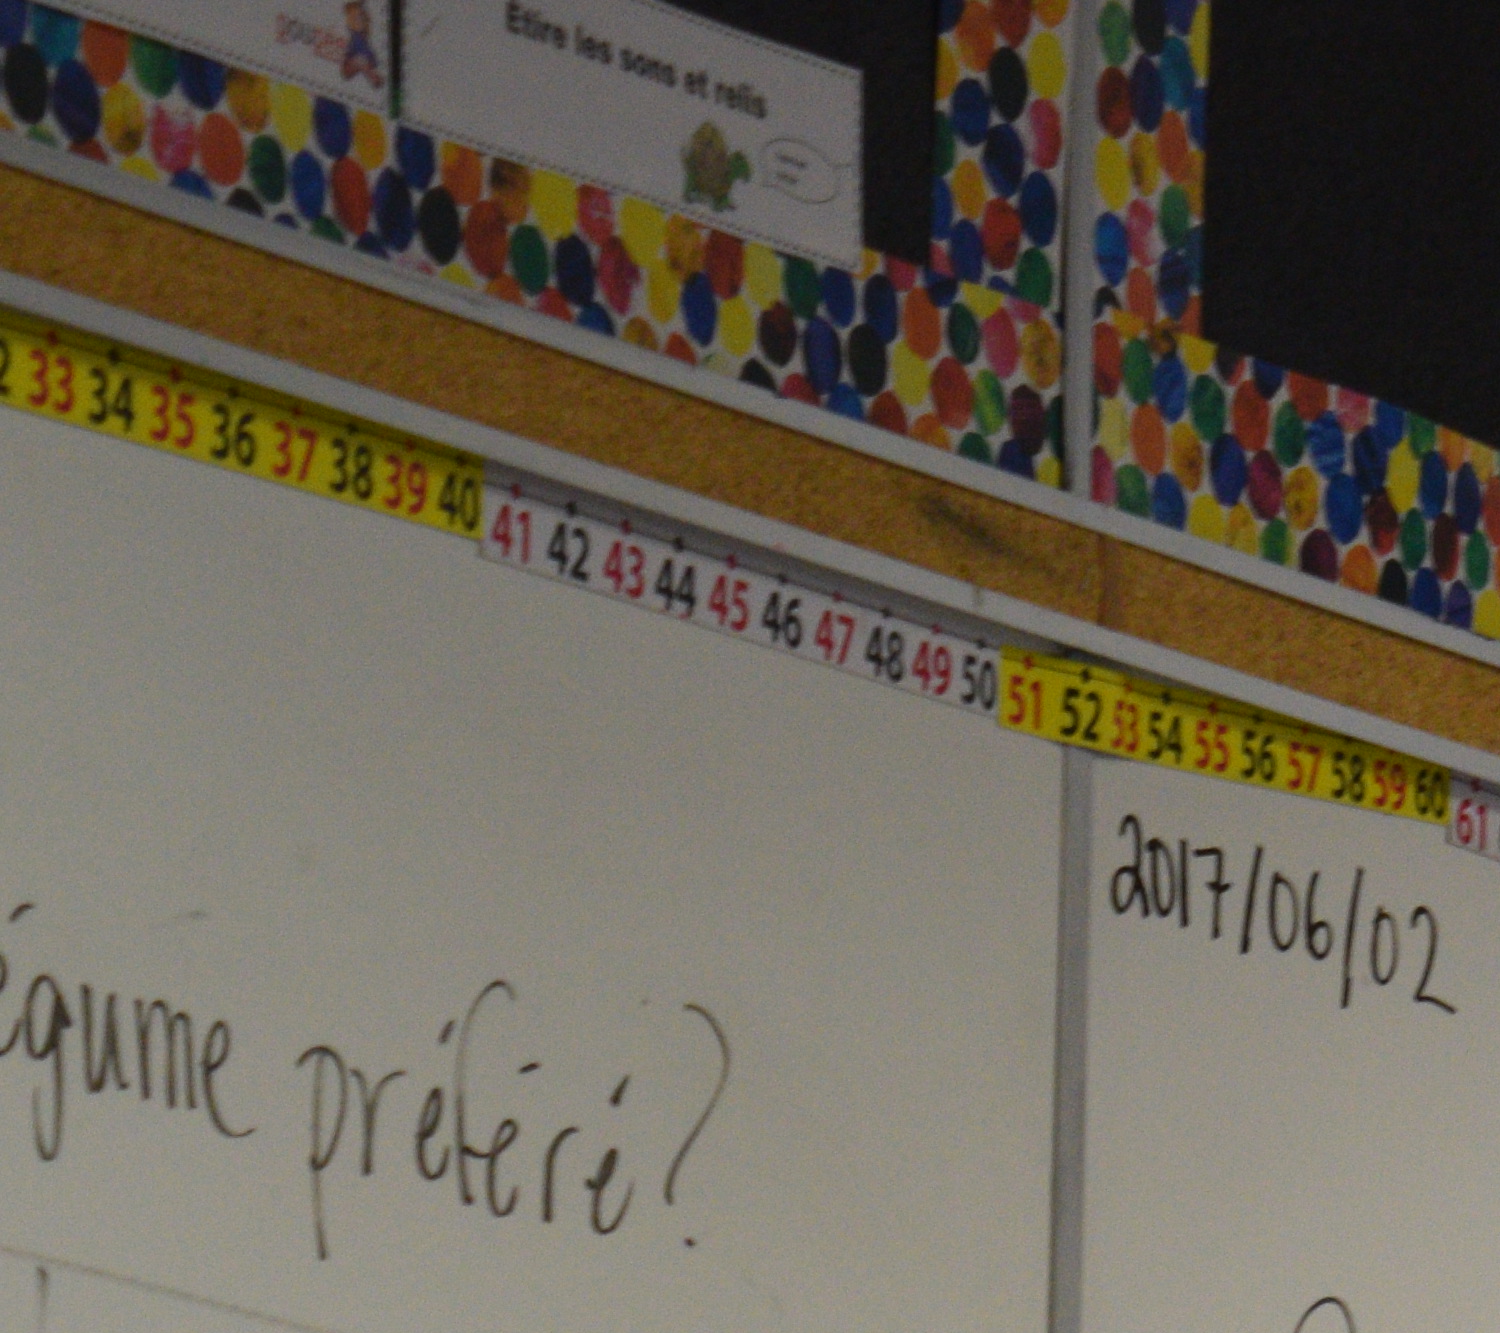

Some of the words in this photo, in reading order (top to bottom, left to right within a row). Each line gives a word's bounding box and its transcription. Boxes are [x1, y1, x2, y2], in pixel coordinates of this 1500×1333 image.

[574, 25, 613, 65] les
[620, 47, 677, 87] sons
[683, 70, 710, 99] et
[715, 81, 767, 120] relis
[30, 348, 74, 412] 33
[89, 367, 133, 432] 34
[150, 385, 194, 449] 35
[210, 403, 255, 467] 36
[272, 420, 317, 482] 37
[330, 438, 374, 499] 38
[382, 454, 428, 514] 39
[437, 472, 481, 531] 40
[491, 504, 532, 562] 41
[547, 522, 591, 581] 42
[604, 541, 644, 598] 43
[655, 559, 697, 618] 44
[708, 575, 749, 631] 45
[762, 592, 802, 648] 46
[815, 610, 855, 664] 47
[865, 626, 904, 681] 48
[912, 641, 952, 695] 49
[960, 655, 996, 710] 50
[1009, 675, 1041, 730] 51
[1060, 687, 1101, 741] 52
[1111, 700, 1138, 753] 53
[1148, 710, 1182, 763] 54
[1195, 720, 1230, 772] 55
[1242, 729, 1276, 782] 56
[1287, 740, 1321, 793] 57
[1332, 750, 1364, 801] 58
[1373, 760, 1406, 810] 59
[1415, 768, 1448, 819] 60
[1457, 799, 1486, 852] 61
[1108, 814, 1456, 1014] 2017/06/02
